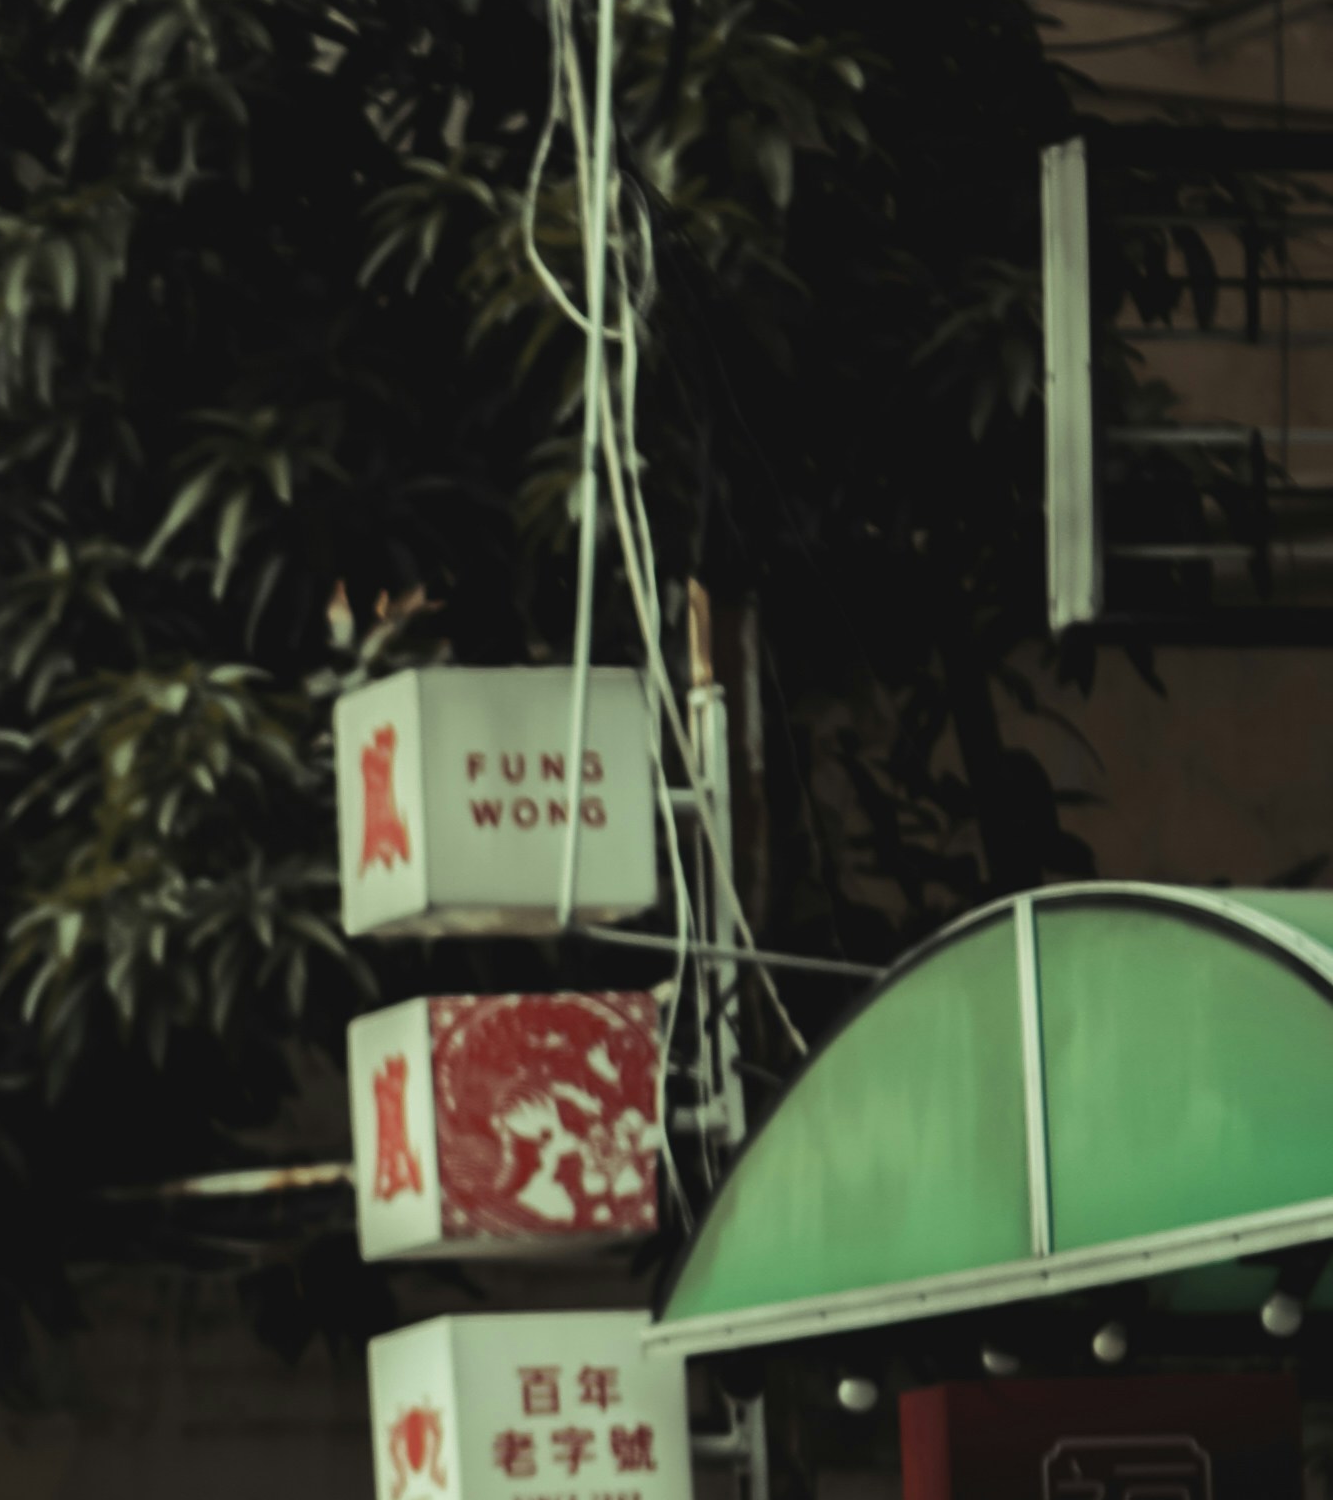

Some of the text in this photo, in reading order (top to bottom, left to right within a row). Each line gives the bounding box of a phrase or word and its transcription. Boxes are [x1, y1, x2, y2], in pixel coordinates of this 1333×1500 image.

[465, 750, 605, 785] FUNG
[469, 798, 608, 829] WONG
[517, 1364, 622, 1416] 百年
[491, 1421, 659, 1480] 老字號
